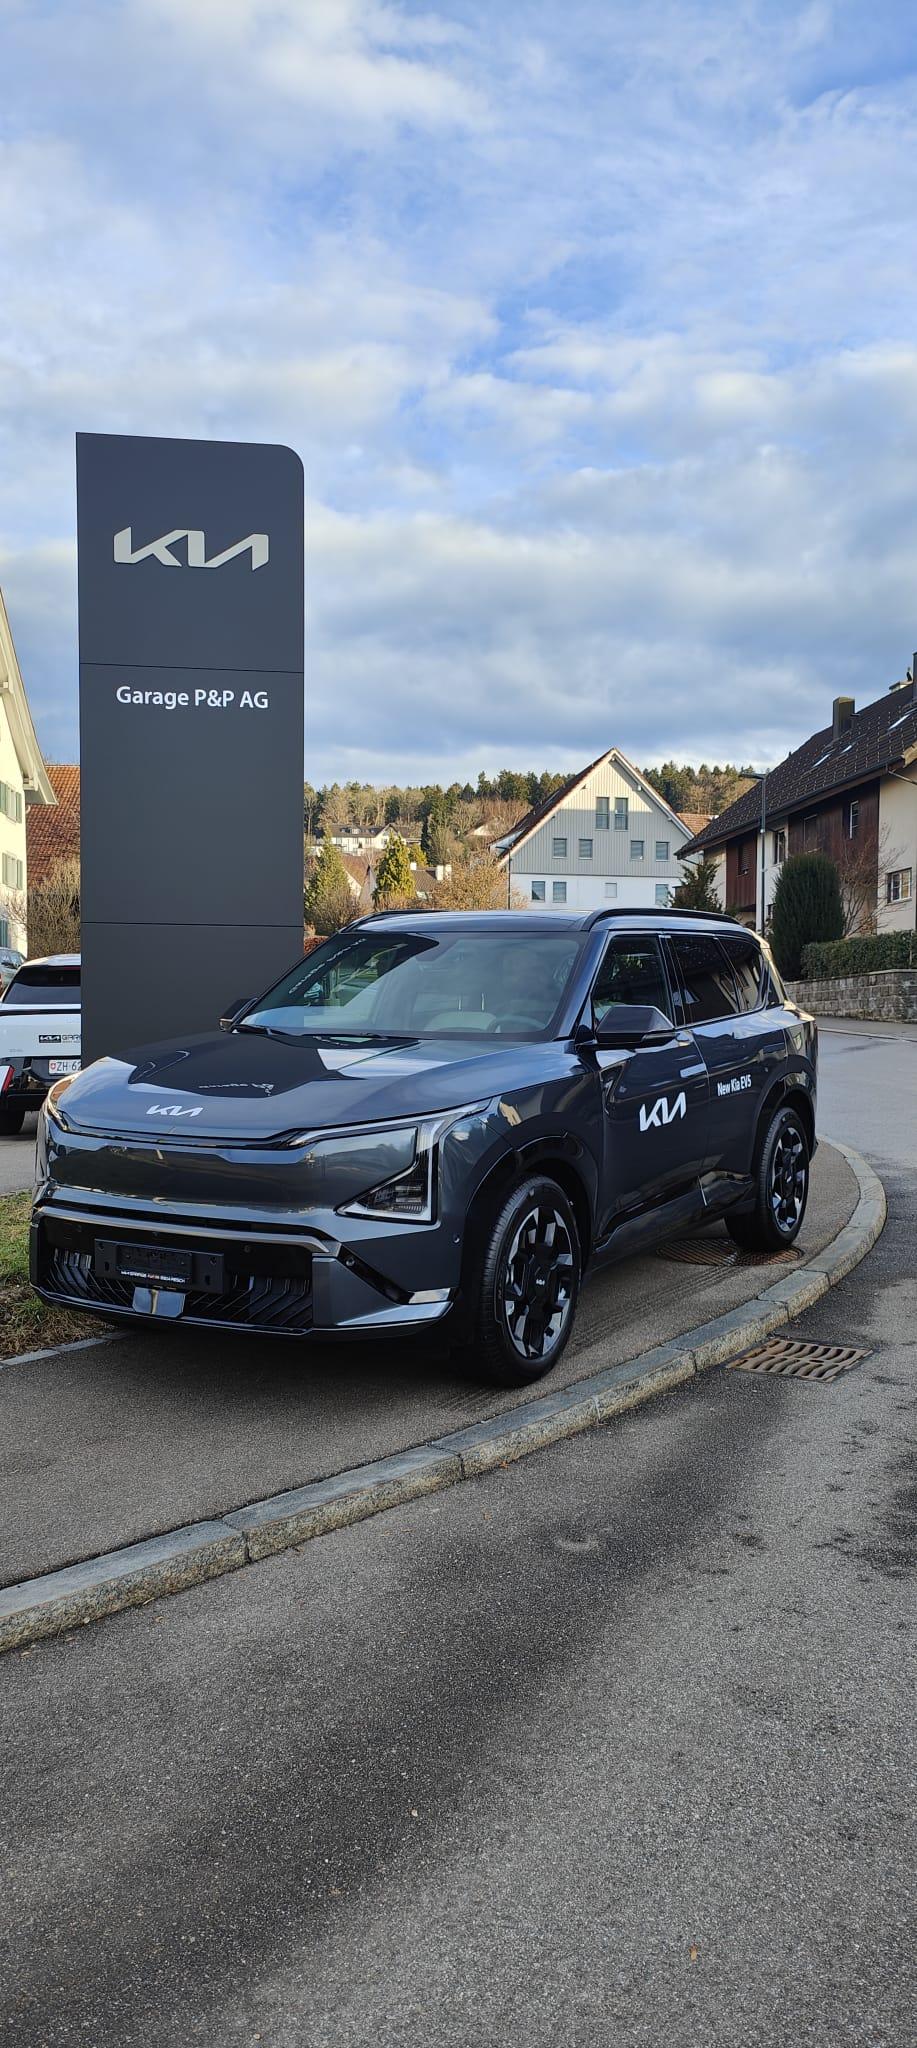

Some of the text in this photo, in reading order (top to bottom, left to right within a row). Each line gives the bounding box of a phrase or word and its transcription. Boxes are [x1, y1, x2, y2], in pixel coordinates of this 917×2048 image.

[113, 526, 269, 571] KIA
[115, 685, 269, 710] Garage P&P AG
[56, 1061, 68, 1072] ZH
[717, 1073, 752, 1097] New Kia EV5
[145, 1104, 204, 1117] KIA
[639, 1091, 687, 1132] KIA
